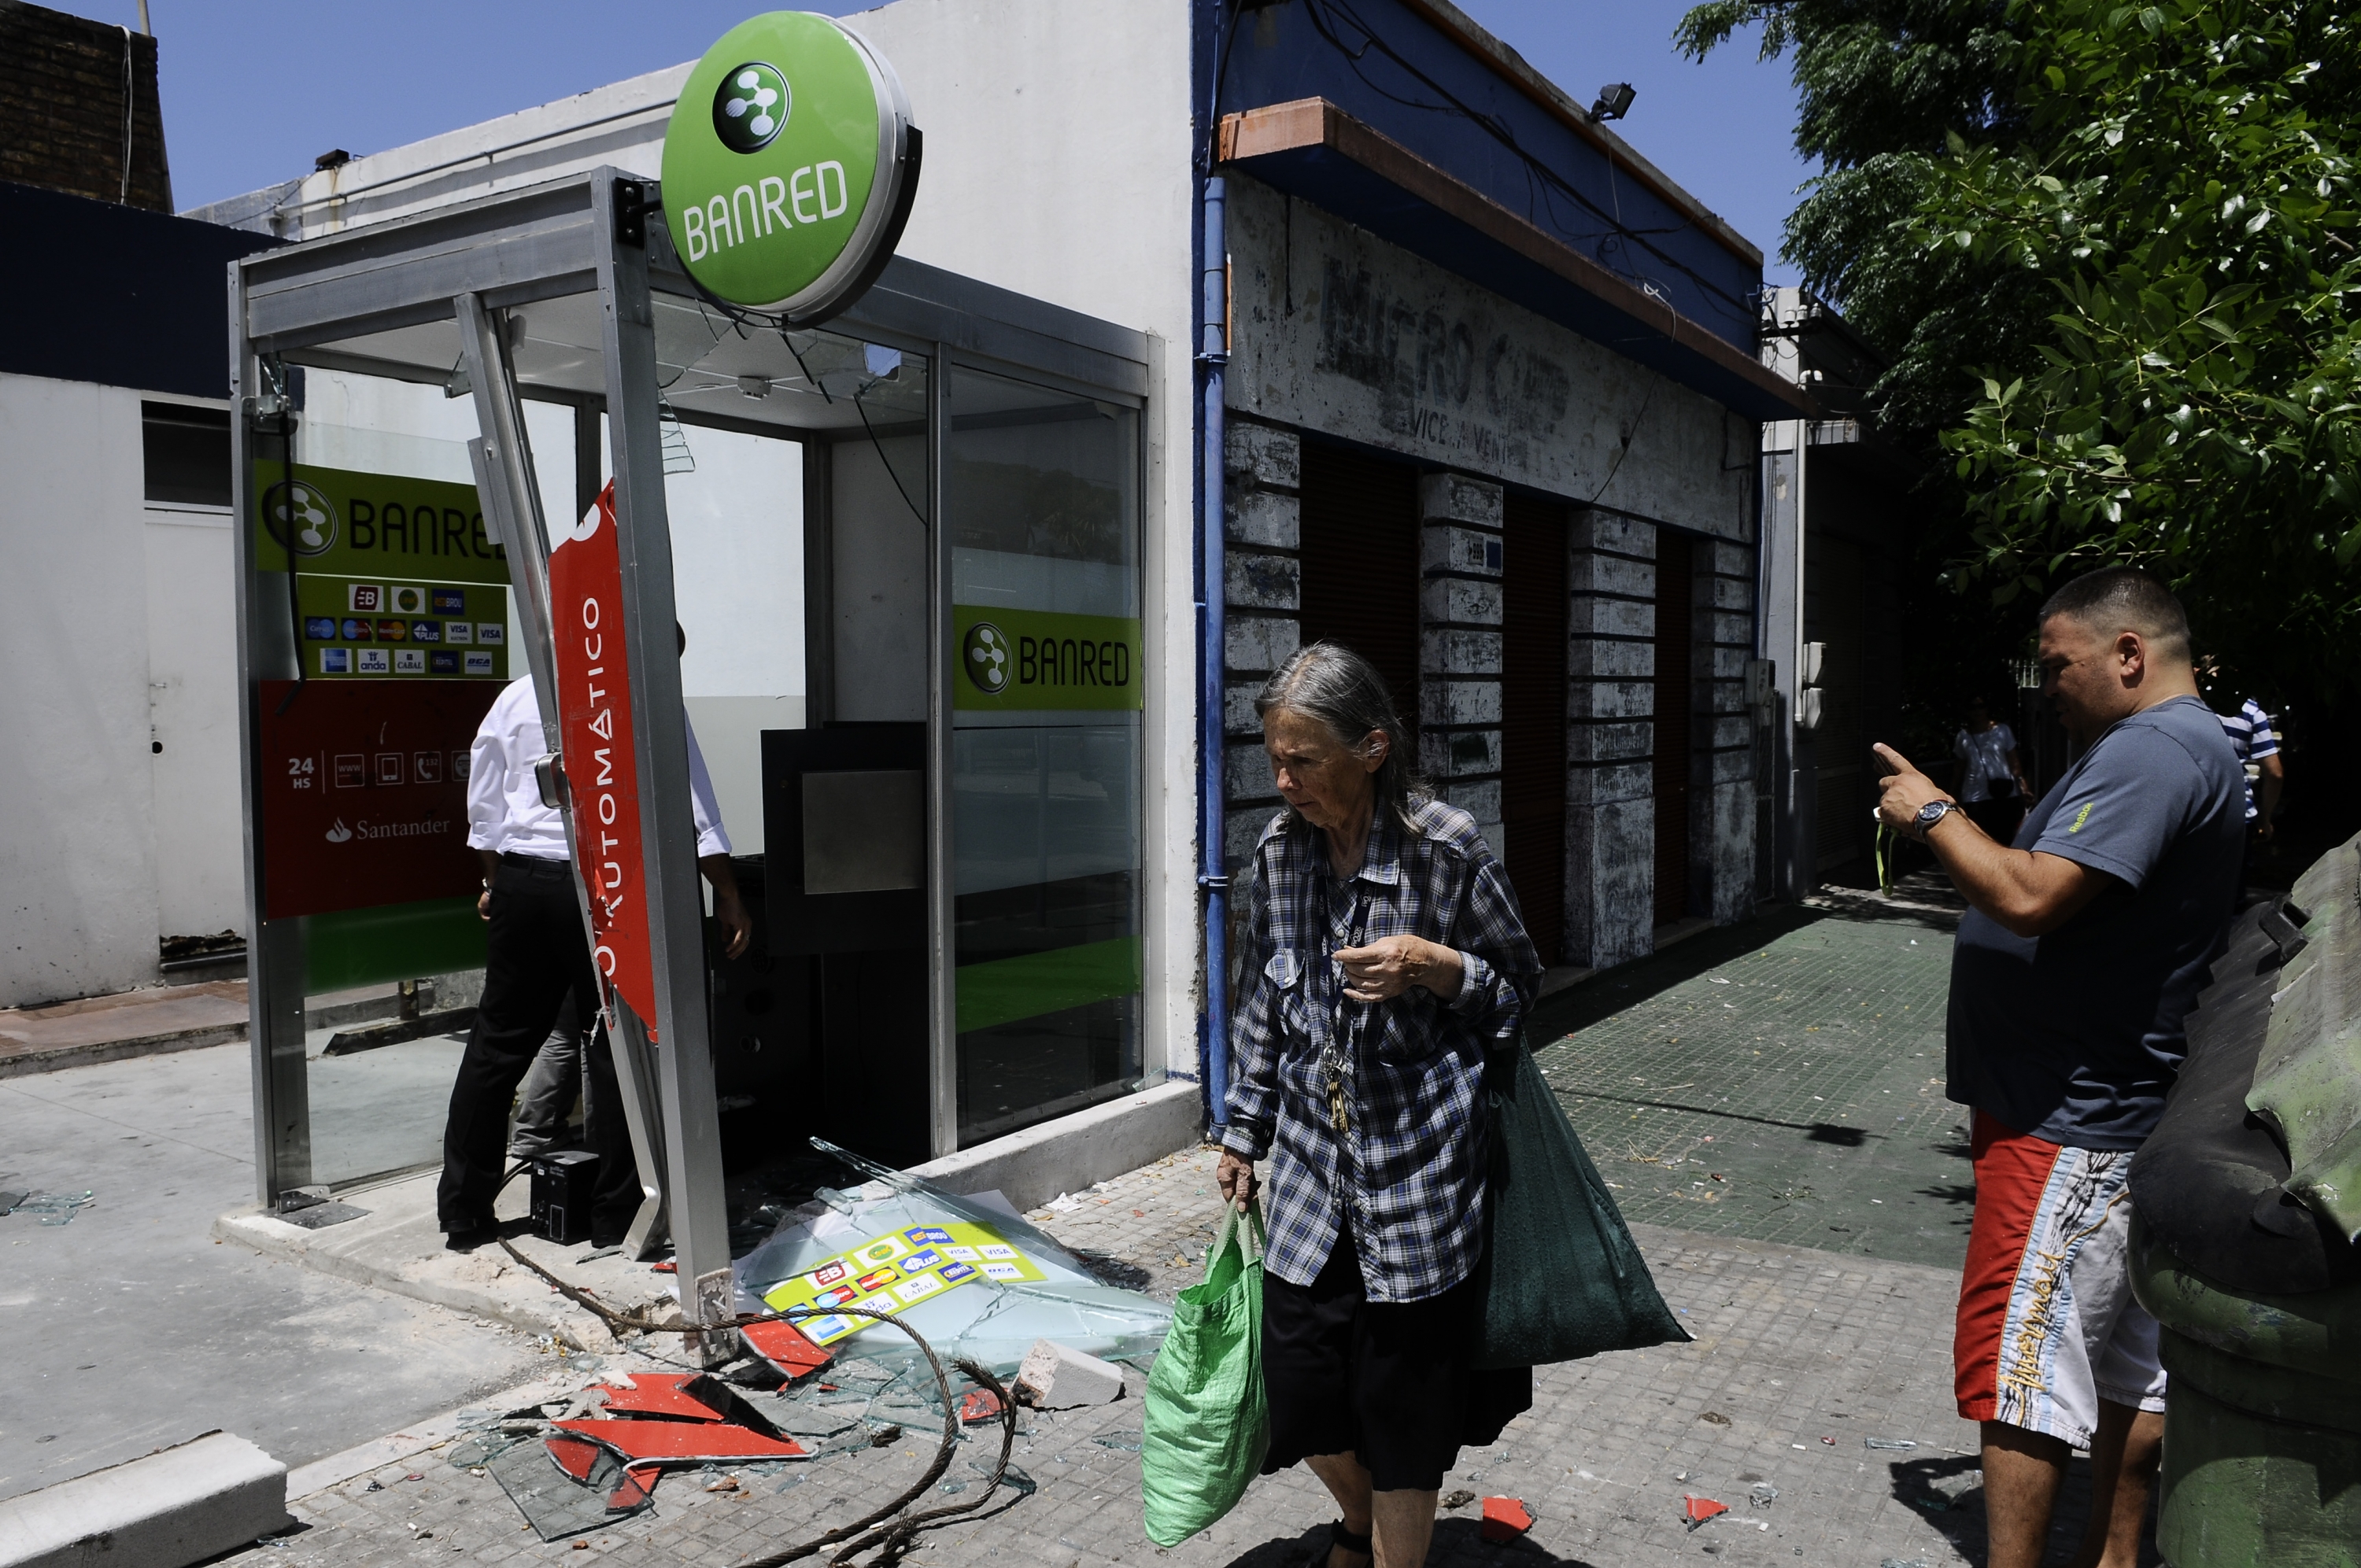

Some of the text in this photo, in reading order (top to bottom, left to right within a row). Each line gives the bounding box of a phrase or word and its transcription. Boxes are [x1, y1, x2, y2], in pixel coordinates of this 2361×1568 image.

[683, 160, 848, 263] BANRED
[419, 632, 440, 640] PLUS
[481, 629, 501, 639] VISA
[360, 661, 386, 670] anda
[1020, 636, 1129, 686] BANRED
[288, 758, 314, 775] 24
[293, 778, 311, 788] HS
[2068, 802, 2094, 833] Reebok
[357, 819, 450, 839] Santander
[915, 1256, 940, 1270] PLUS
[861, 1271, 895, 1289] MasterCard
[904, 1283, 937, 1299] CABAL
